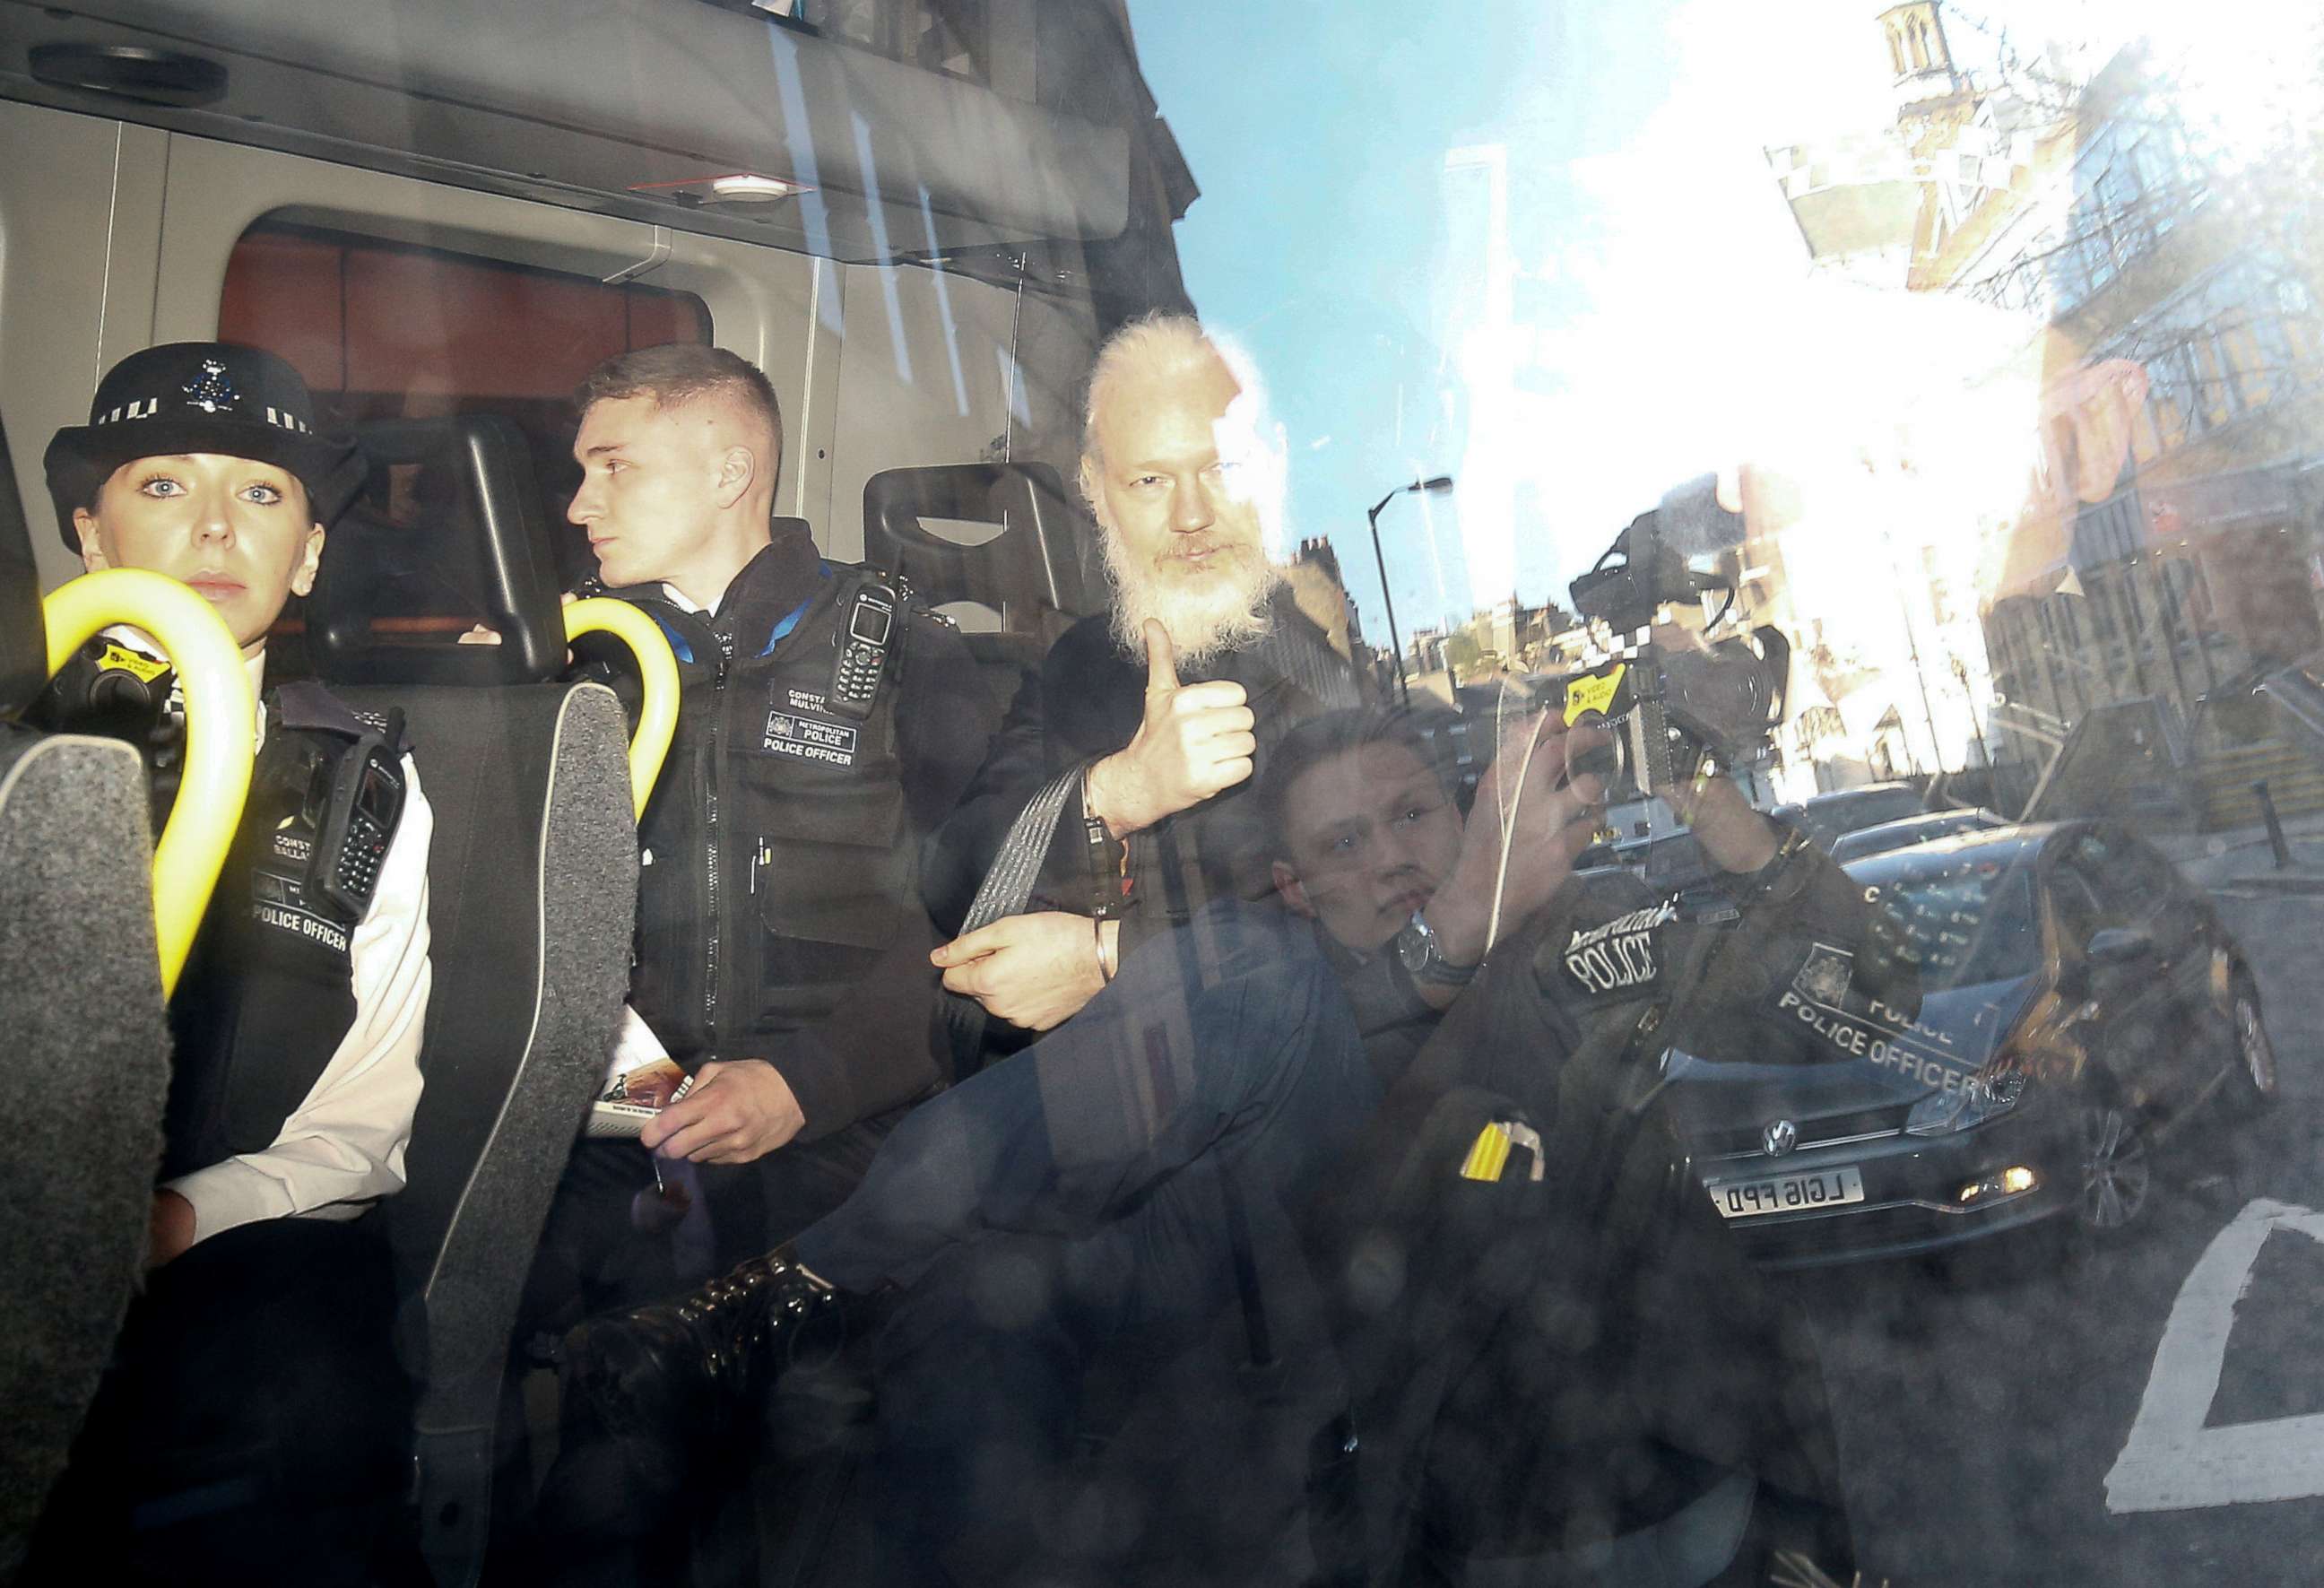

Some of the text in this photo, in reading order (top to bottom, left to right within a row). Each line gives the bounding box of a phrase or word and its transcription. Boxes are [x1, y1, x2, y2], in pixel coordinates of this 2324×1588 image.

[799, 721, 849, 738] METROPOLITAN
[803, 729, 842, 746] POLICE
[764, 738, 852, 766] POLICE OFFICER
[253, 904, 300, 931] POLICE
[303, 918, 346, 952] OFFICER
[1566, 932, 1657, 994] POLICE
[1778, 991, 1980, 1102] POLICE OFFICER
